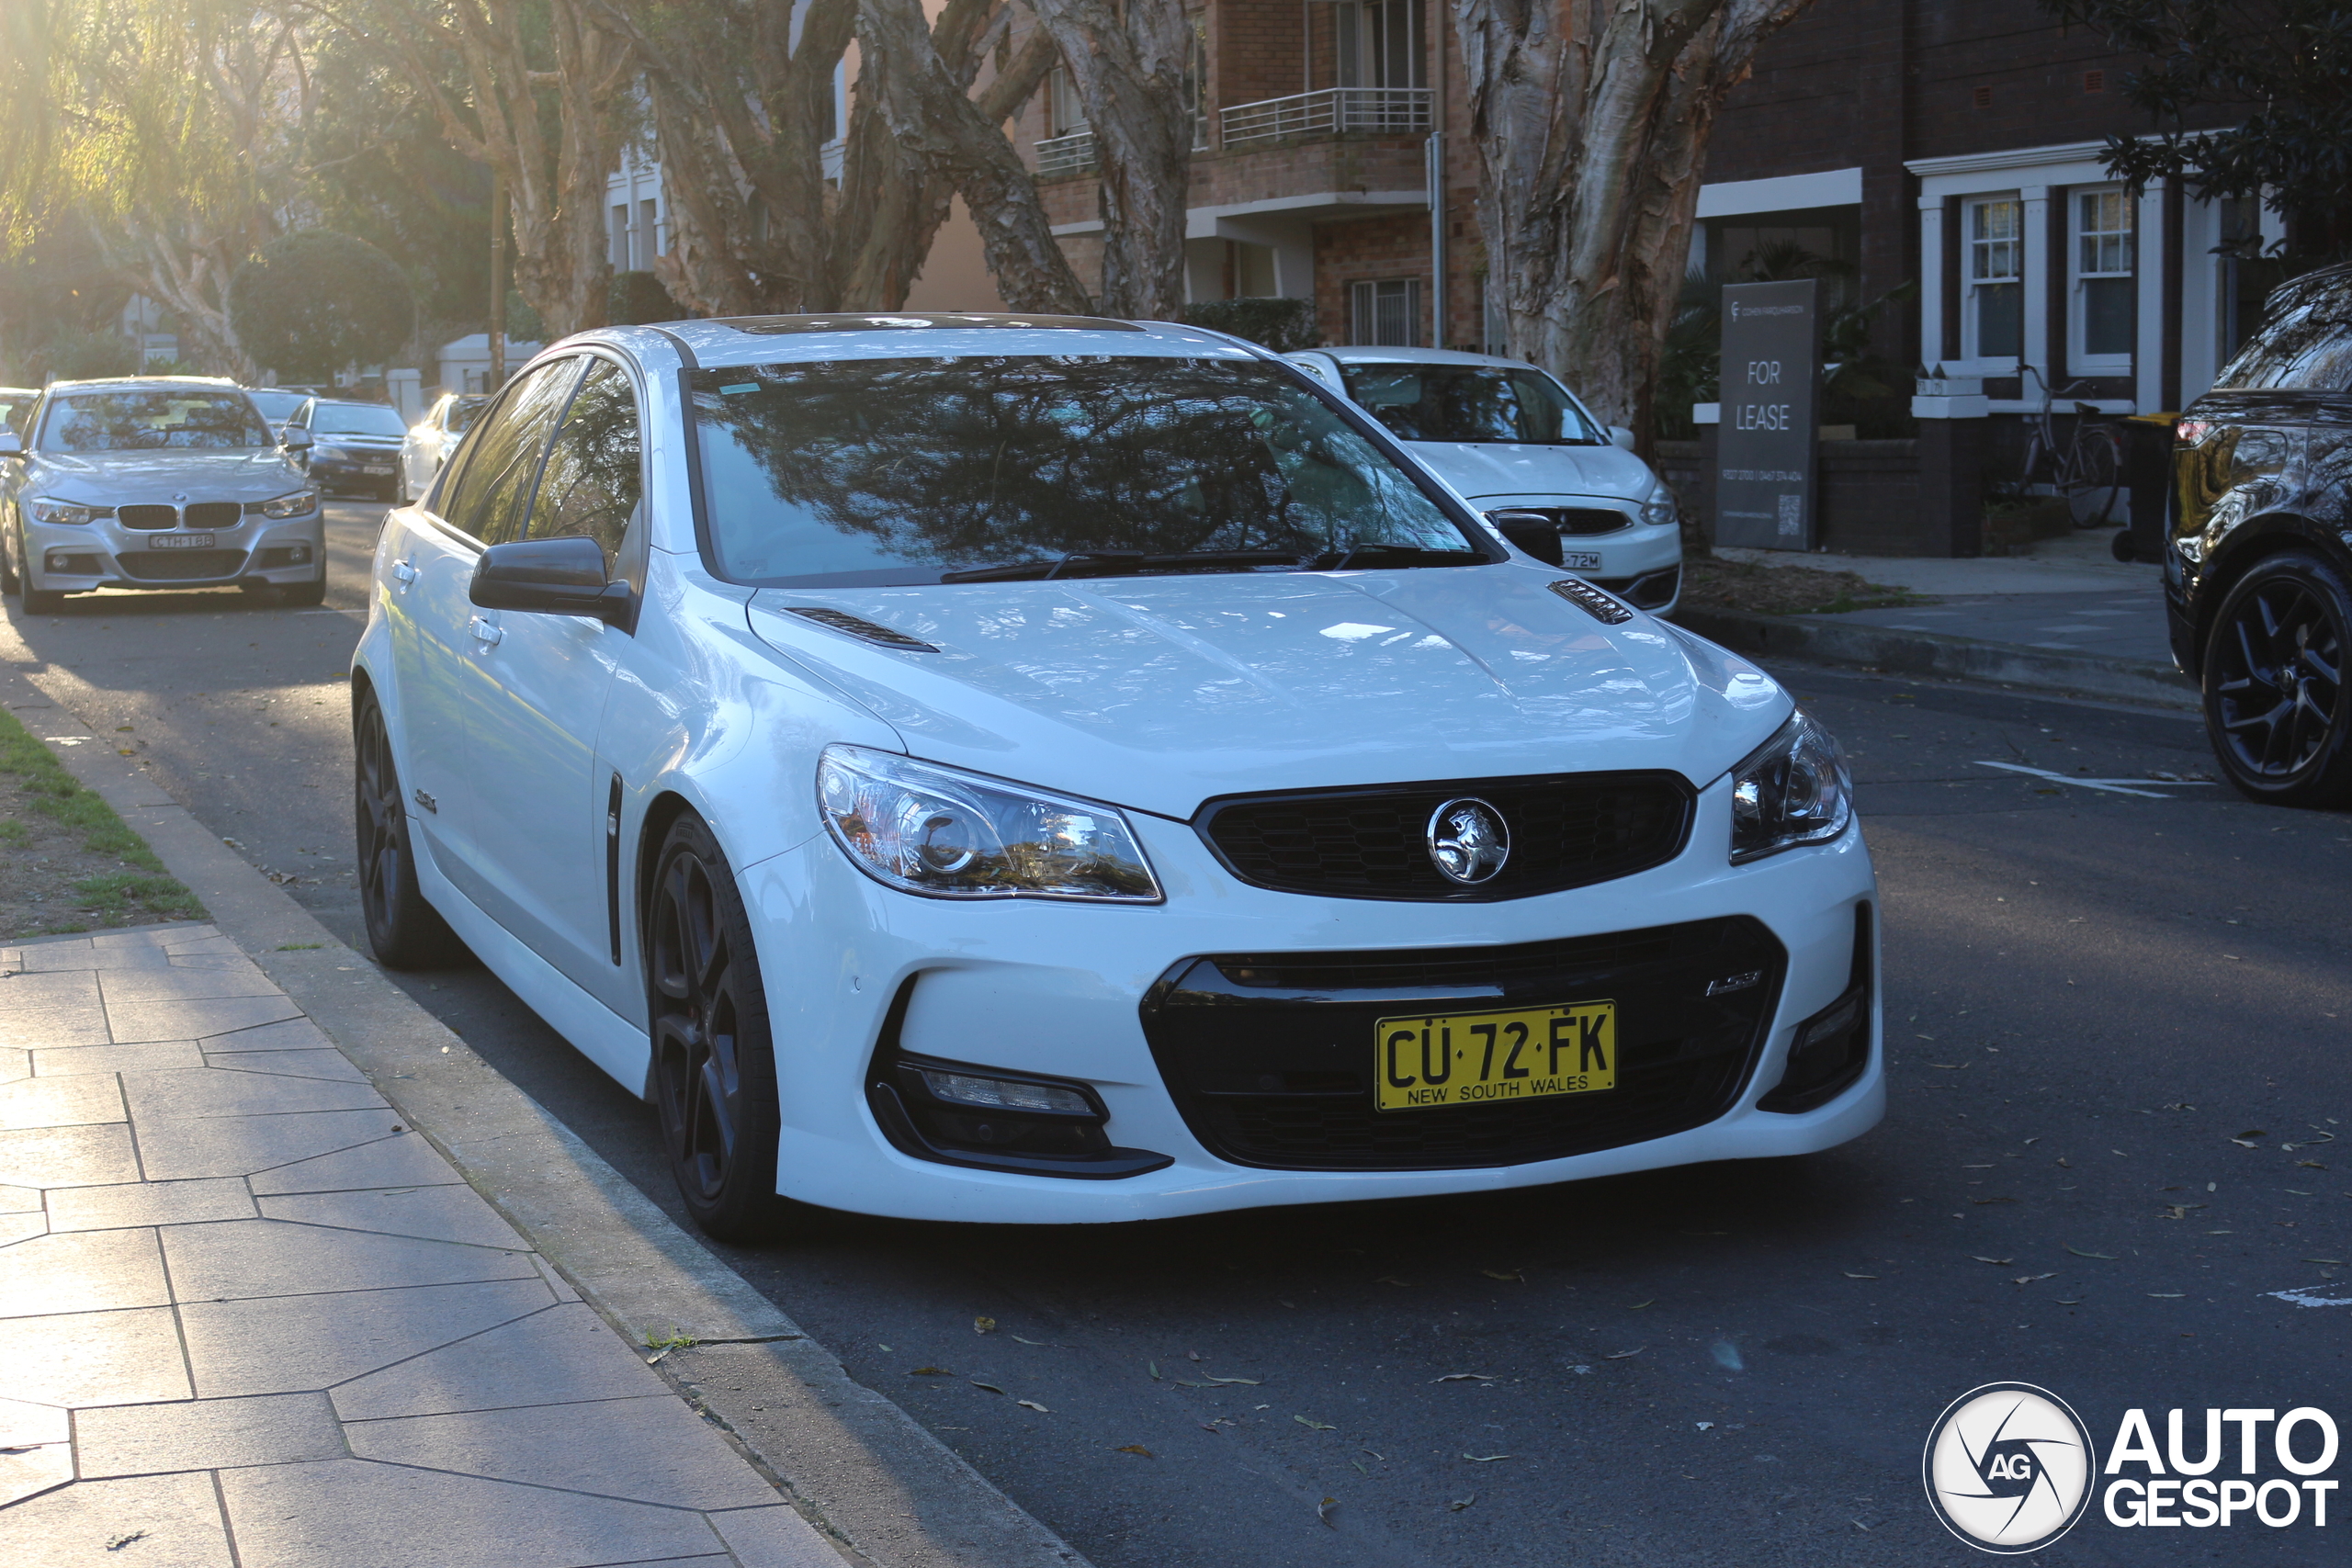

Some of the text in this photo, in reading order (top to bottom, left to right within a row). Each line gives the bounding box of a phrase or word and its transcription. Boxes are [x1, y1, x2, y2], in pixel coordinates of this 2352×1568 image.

[1747, 361, 1781, 385] FOR
[1736, 404, 1790, 430] LEASE
[1408, 1075, 1589, 1105] NEW SOUTH WALES
